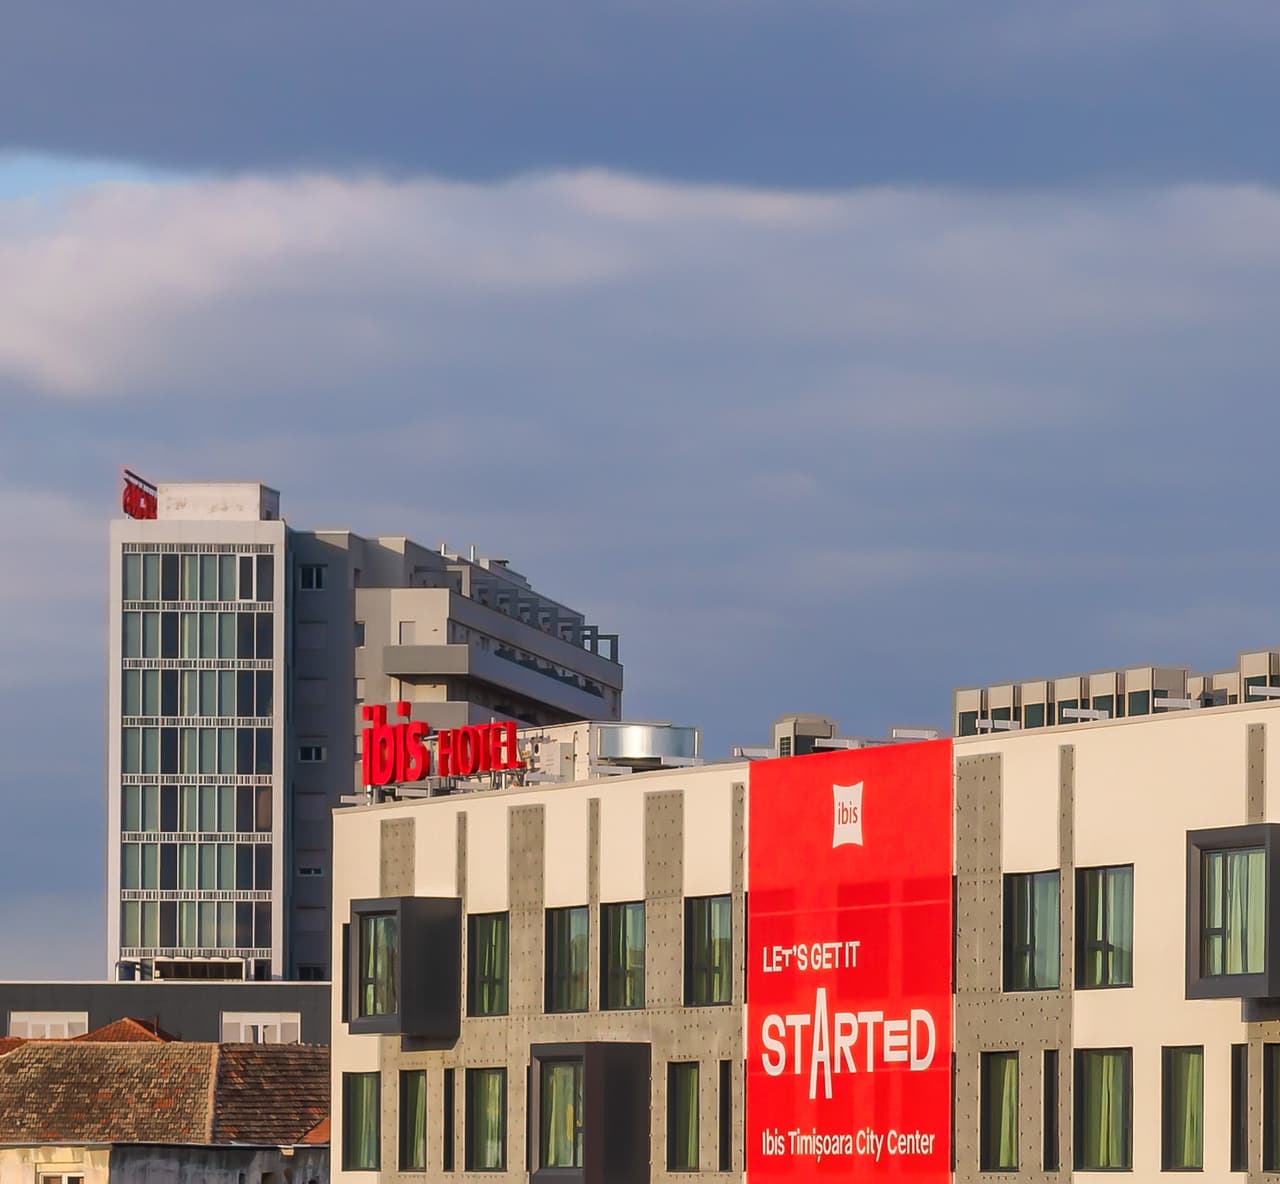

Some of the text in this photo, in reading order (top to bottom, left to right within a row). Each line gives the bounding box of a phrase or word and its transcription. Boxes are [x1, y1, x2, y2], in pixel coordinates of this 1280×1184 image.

[362, 700, 527, 786] ibis HOTEL
[837, 801, 859, 825] ibis
[810, 942, 843, 970] GET
[845, 940, 860, 968] IT
[761, 987, 936, 1100] STARTED
[762, 1128, 785, 1156] Ibis
[855, 1127, 884, 1162] City
[887, 1129, 936, 1155] Center
